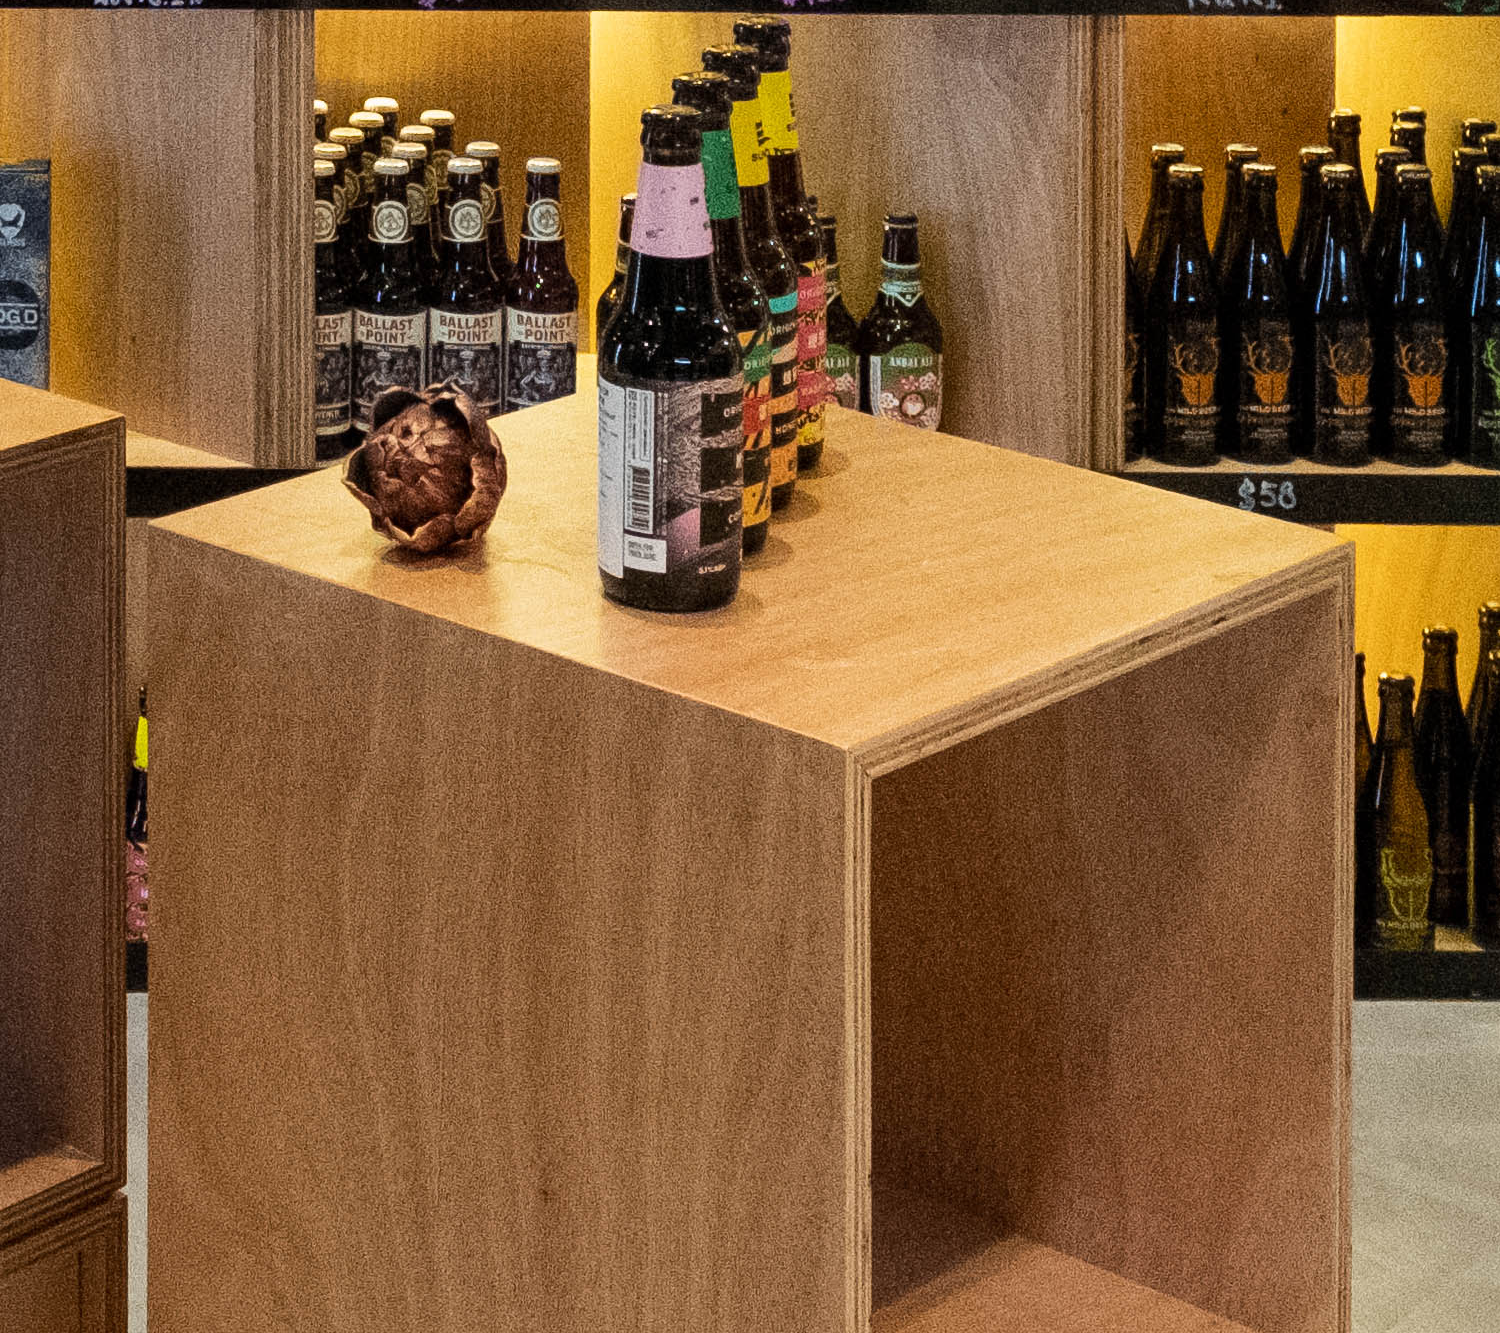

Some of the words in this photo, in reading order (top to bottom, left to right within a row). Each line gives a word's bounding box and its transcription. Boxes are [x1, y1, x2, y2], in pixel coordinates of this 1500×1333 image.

[359, 317, 413, 330] BALLAST
[440, 316, 494, 329] BALLAST
[517, 316, 571, 328] BALLAST
[366, 330, 406, 342] POINT
[448, 330, 488, 341] POINT
[525, 329, 565, 341] POINT
[1238, 479, 1297, 512] $58
